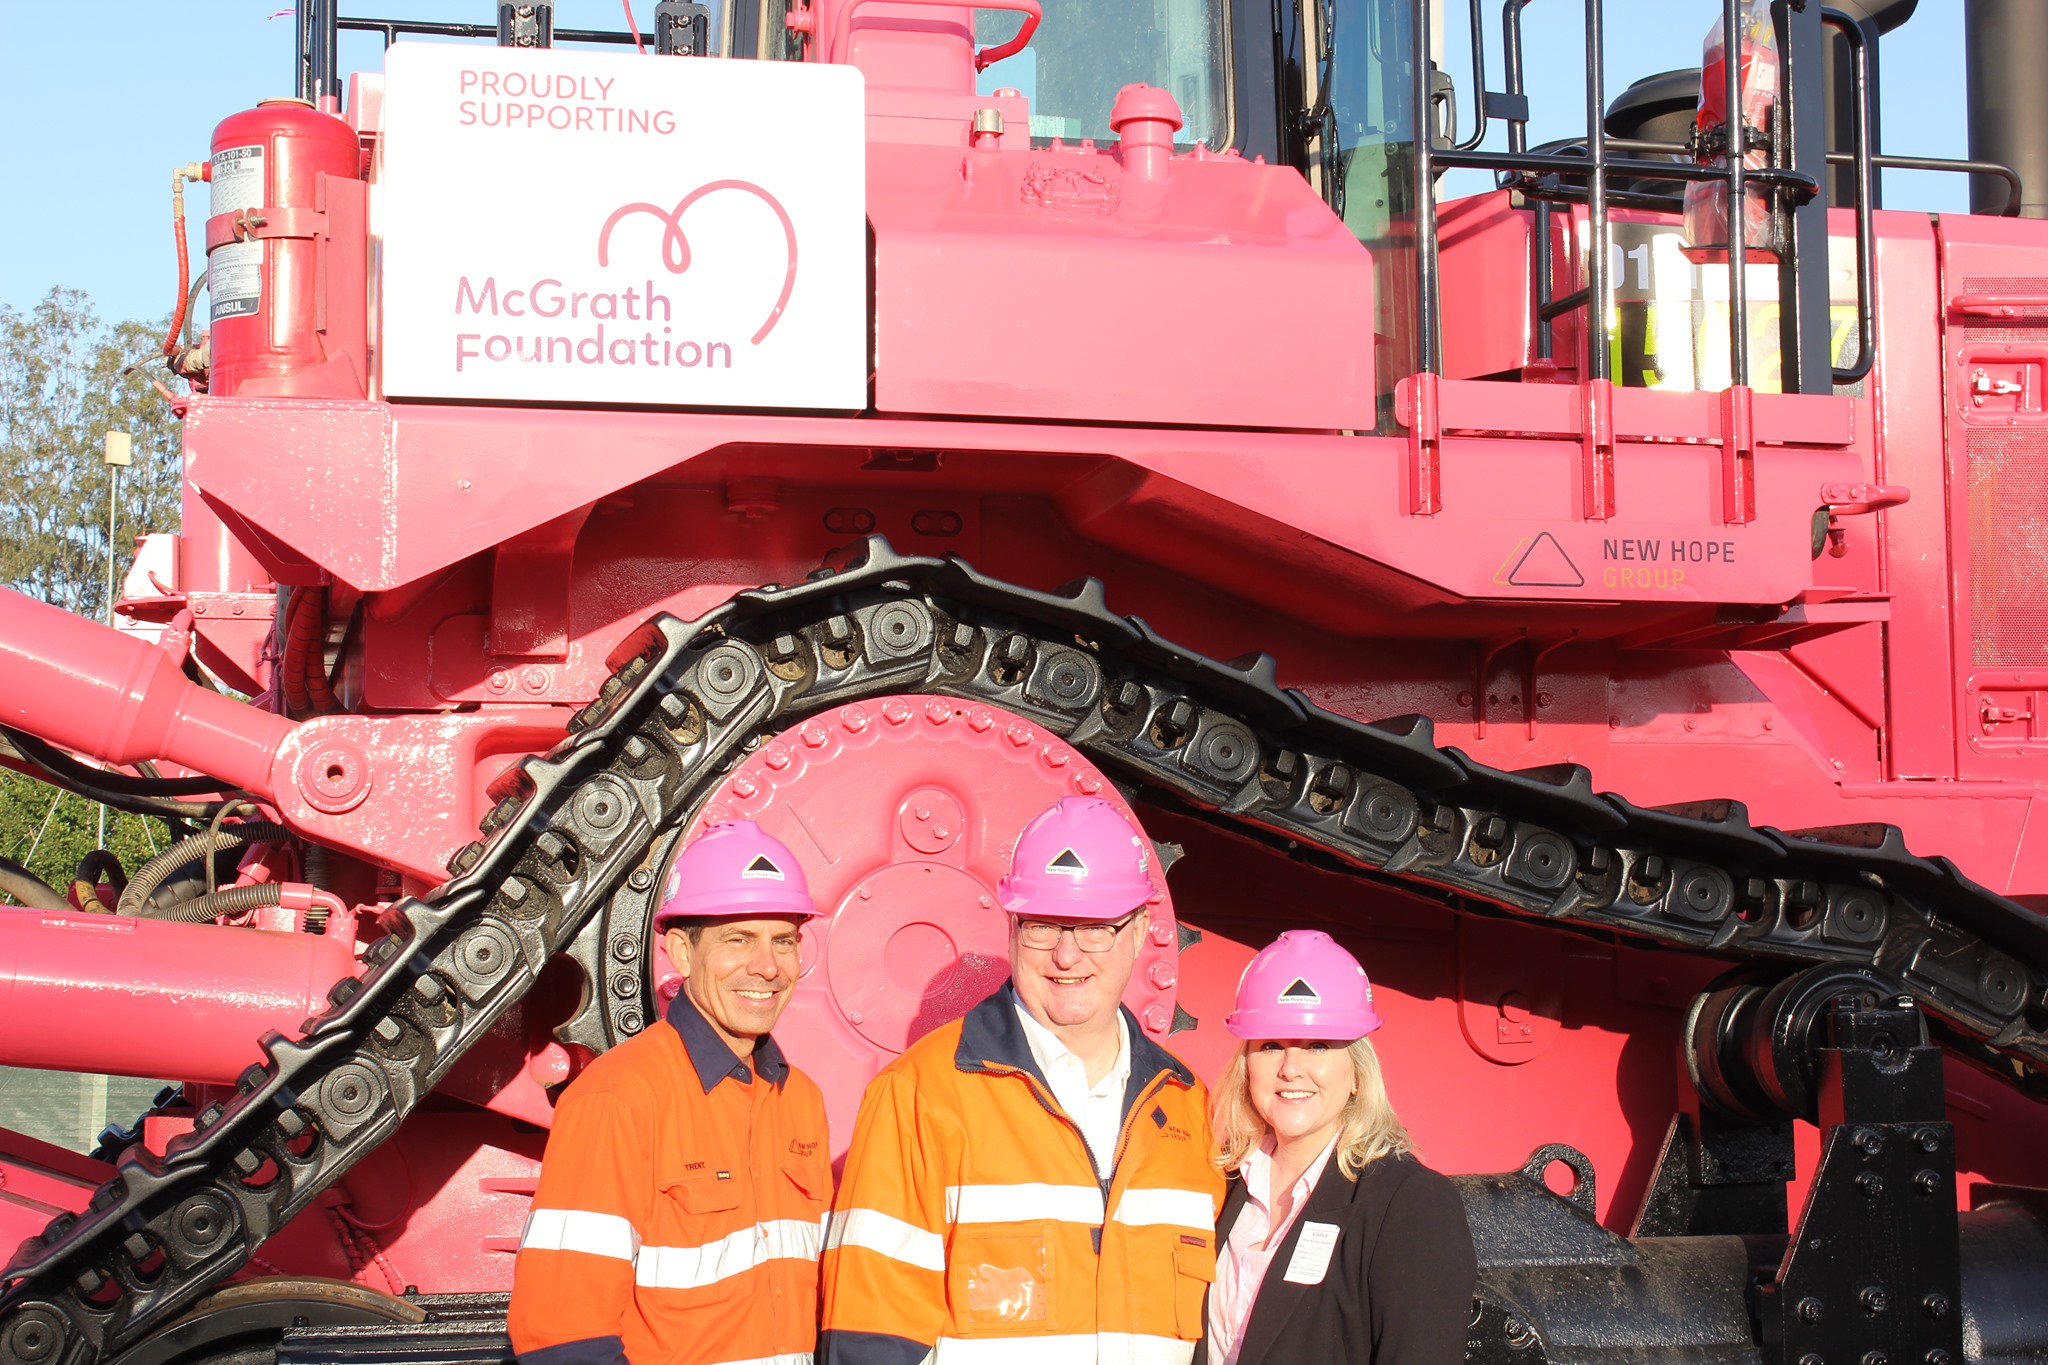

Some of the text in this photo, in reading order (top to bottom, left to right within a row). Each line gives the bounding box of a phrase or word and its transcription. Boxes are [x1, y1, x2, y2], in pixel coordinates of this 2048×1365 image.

[459, 69, 615, 101] PROUDLY
[458, 101, 677, 135] SUPPORTING
[455, 275, 671, 322] McGrath
[455, 323, 733, 373] Foundation
[1603, 539, 1735, 563] NEW HOPE
[1603, 567, 1685, 590] GROUP
[684, 1161, 706, 1171] TRENT
